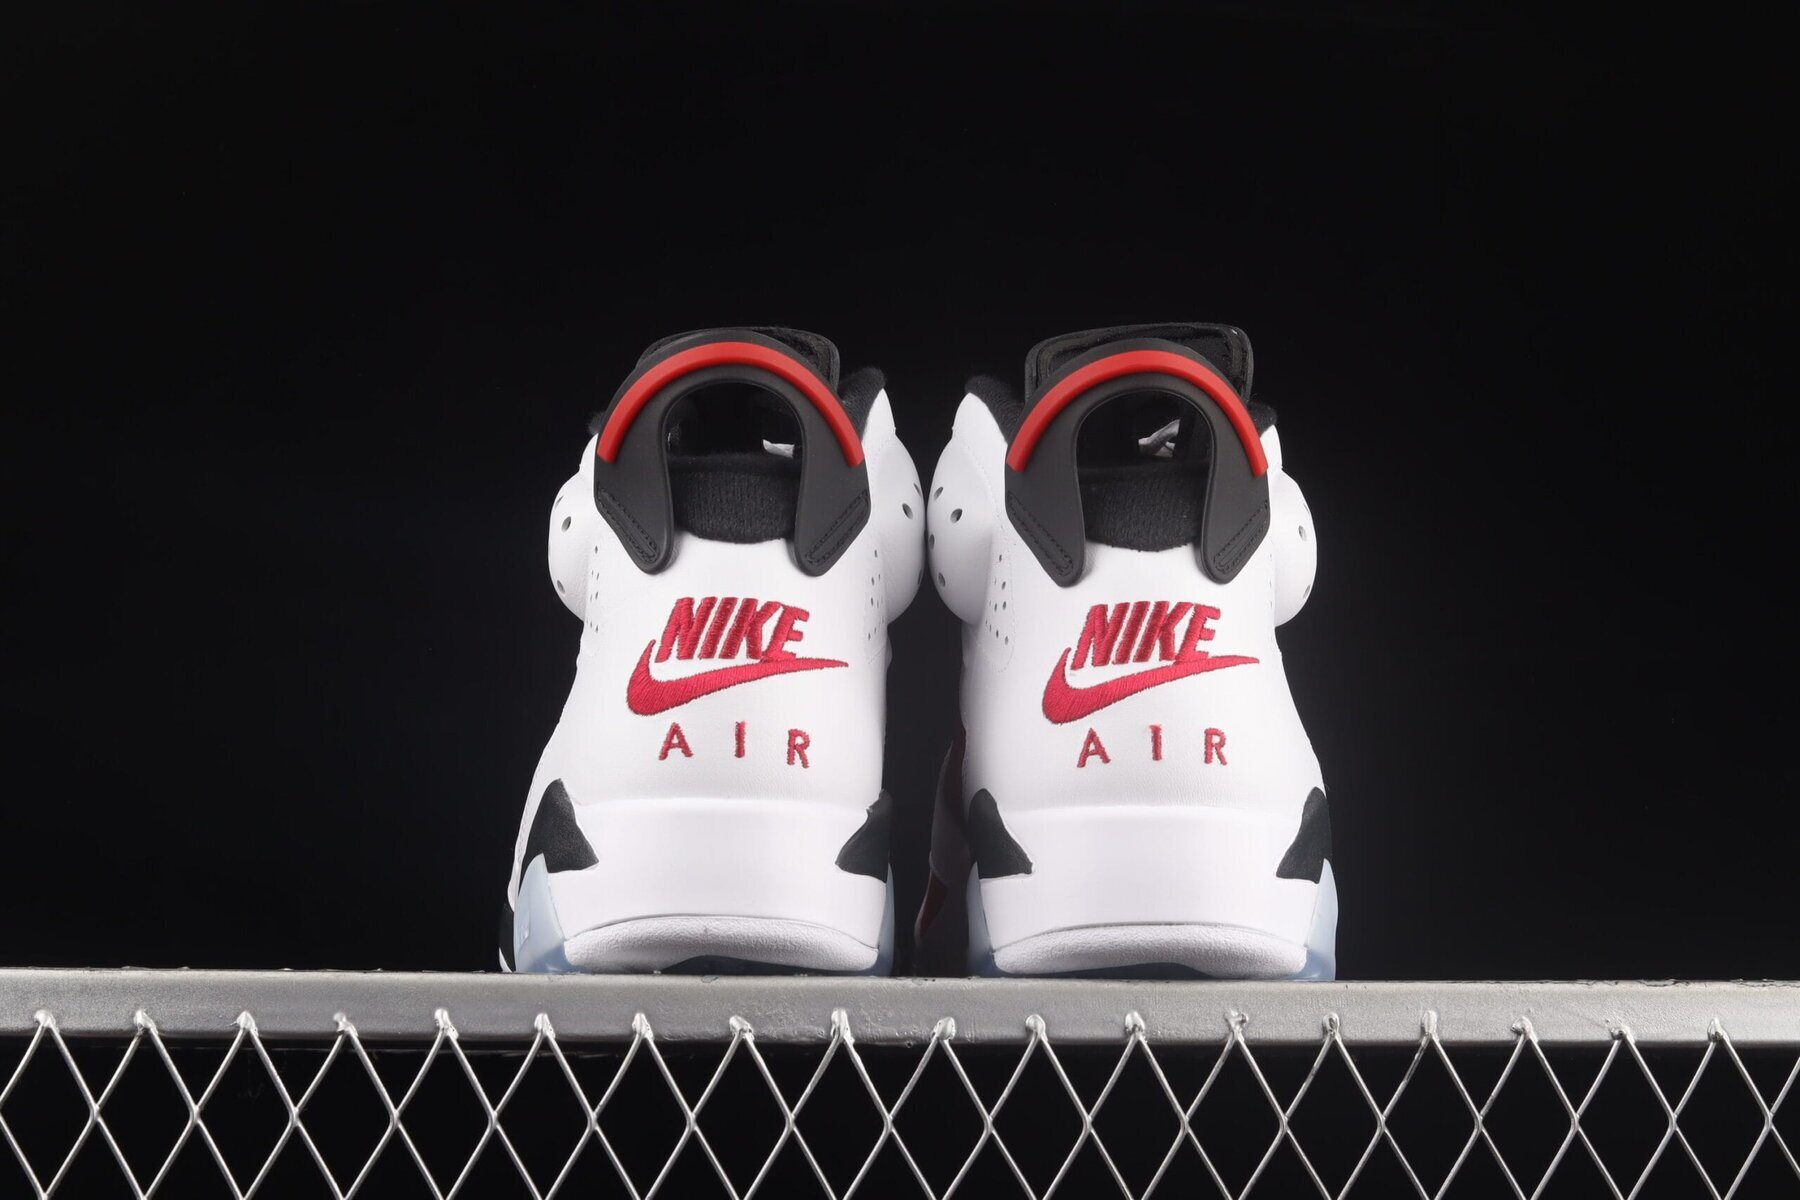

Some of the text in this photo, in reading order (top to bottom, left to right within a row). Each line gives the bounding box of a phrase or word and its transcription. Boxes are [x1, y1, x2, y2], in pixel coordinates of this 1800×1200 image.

[655, 596, 810, 662] NIKE
[1070, 600, 1221, 670] NIKE
[659, 721, 810, 768] AIR
[1076, 724, 1227, 768] AIR
